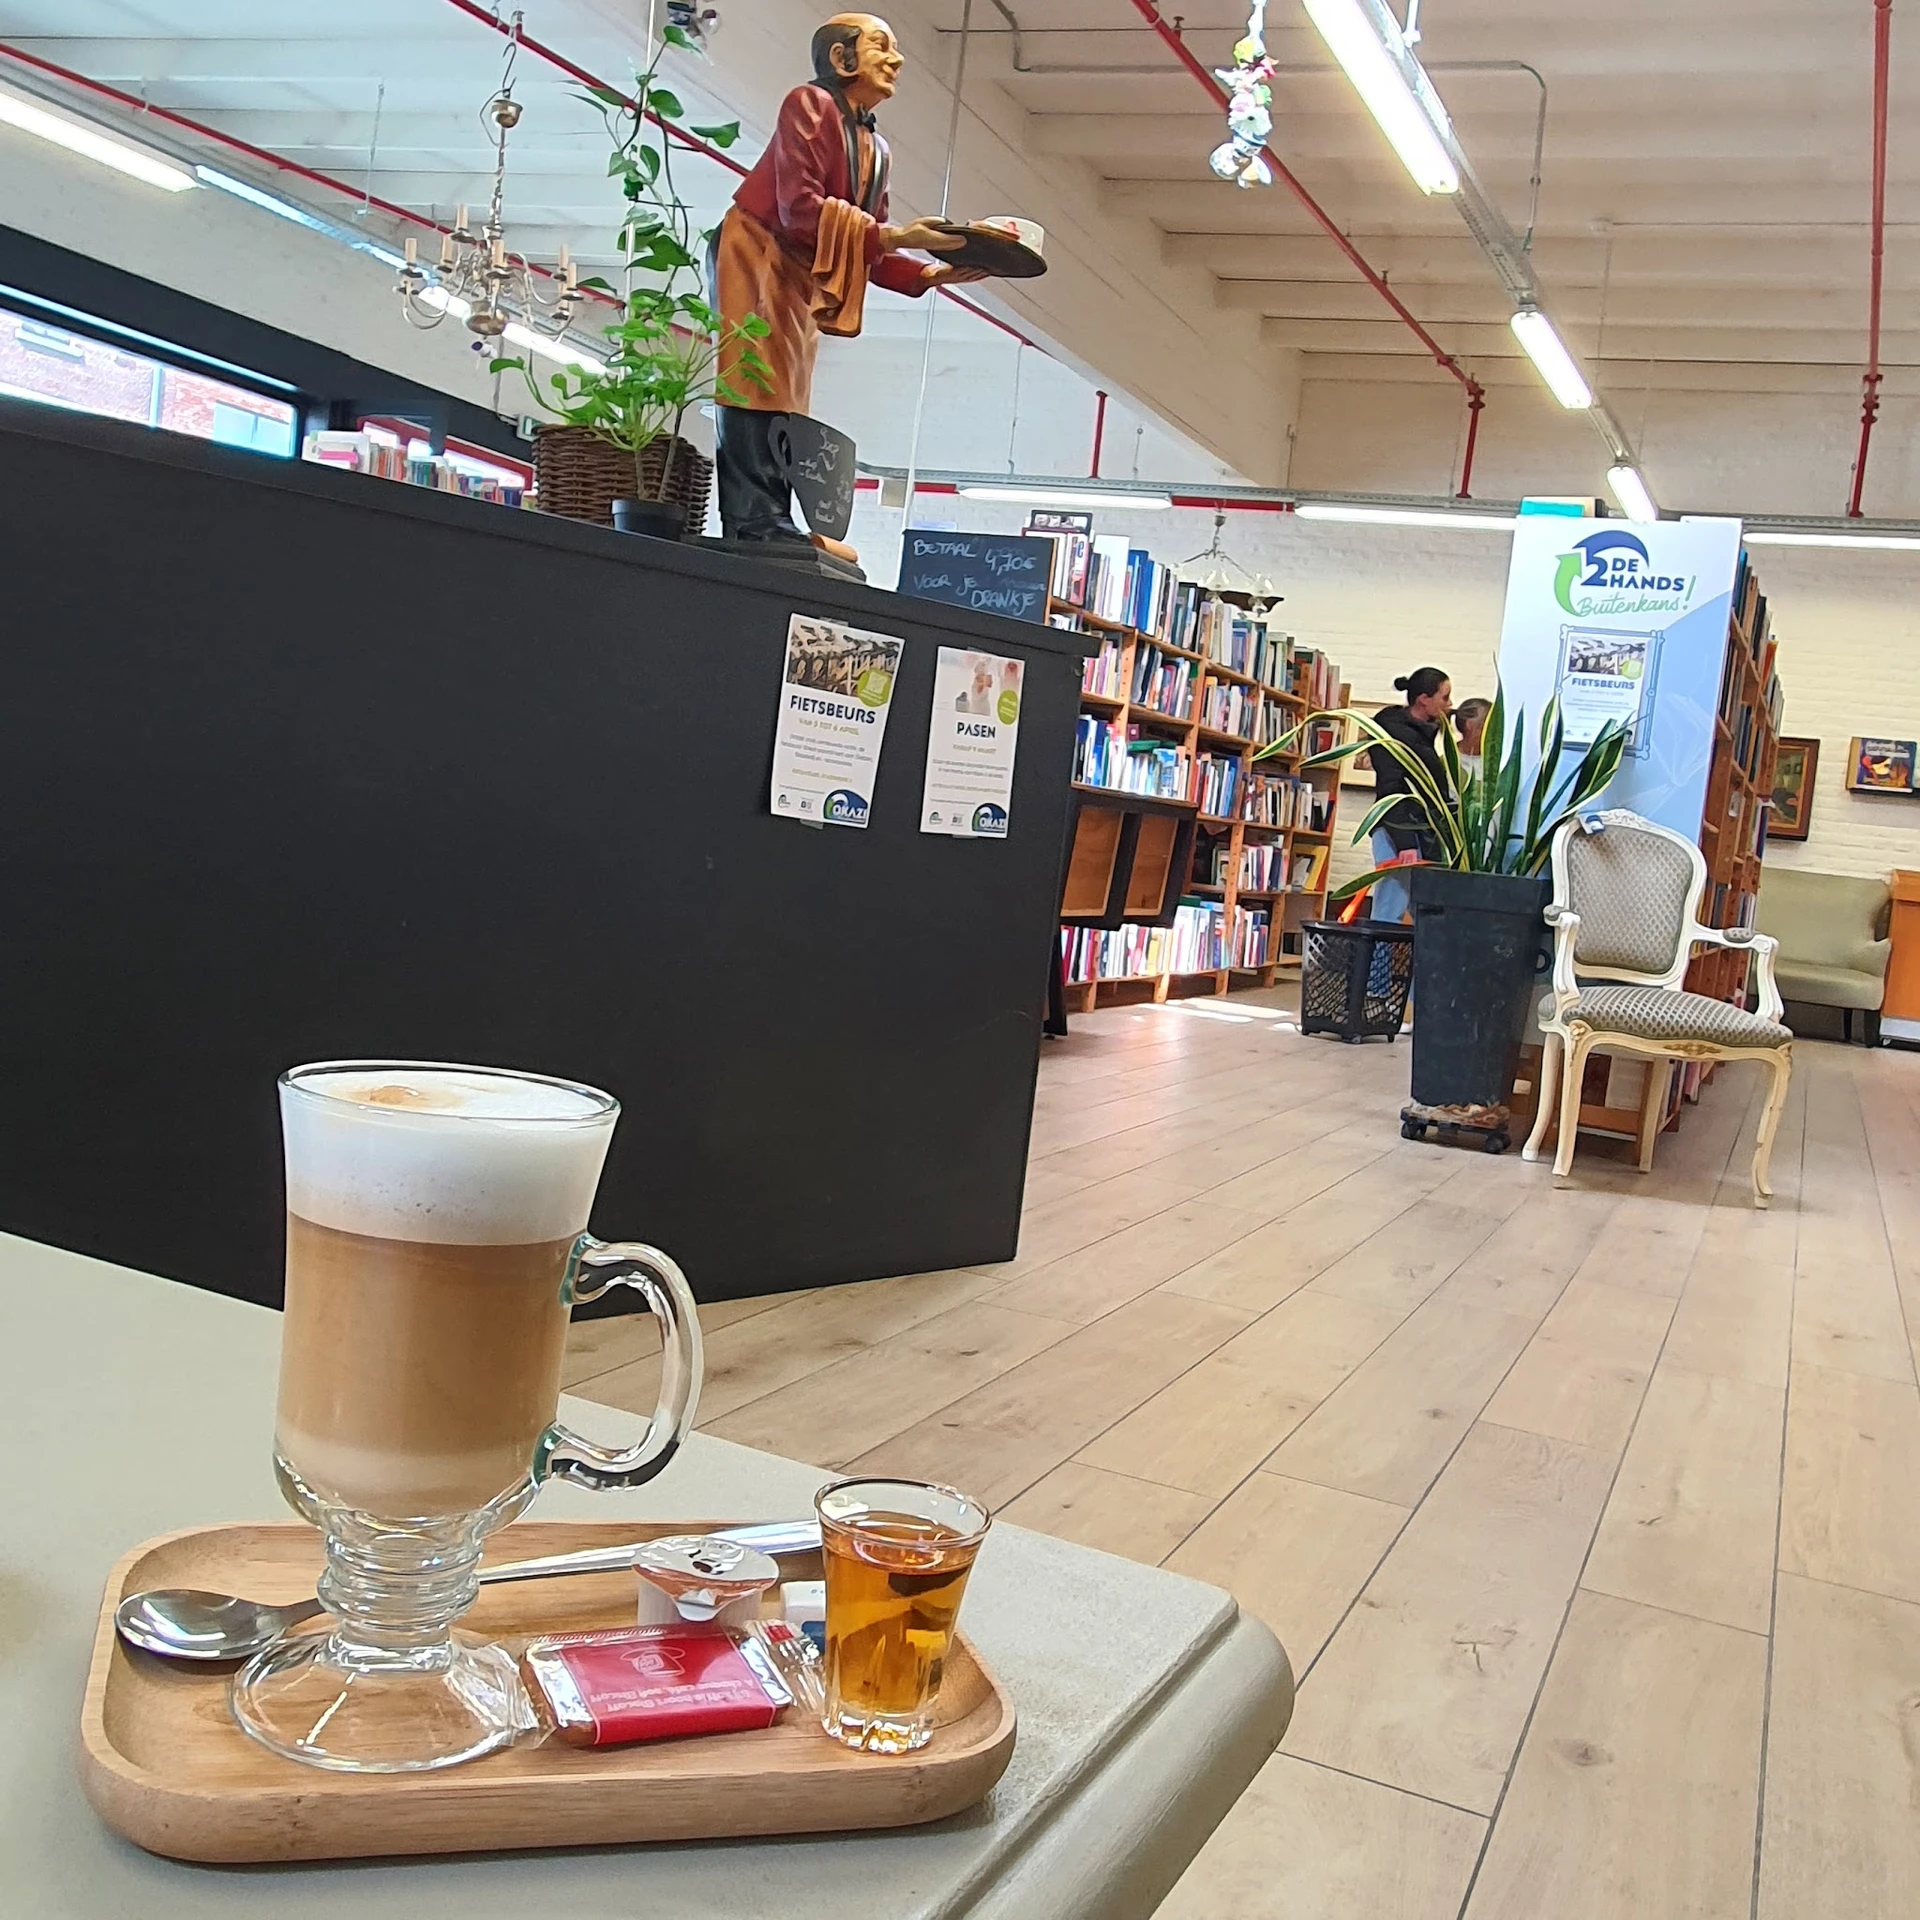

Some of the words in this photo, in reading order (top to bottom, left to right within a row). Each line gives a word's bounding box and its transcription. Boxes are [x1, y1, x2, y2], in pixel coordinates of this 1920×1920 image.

[1611, 557, 1639, 572] DE
[1610, 574, 1685, 592] HANDS
[1571, 677, 1635, 690] FIETSBEURS
[790, 694, 877, 725] FIETSBEURS
[957, 721, 996, 739] PASEN
